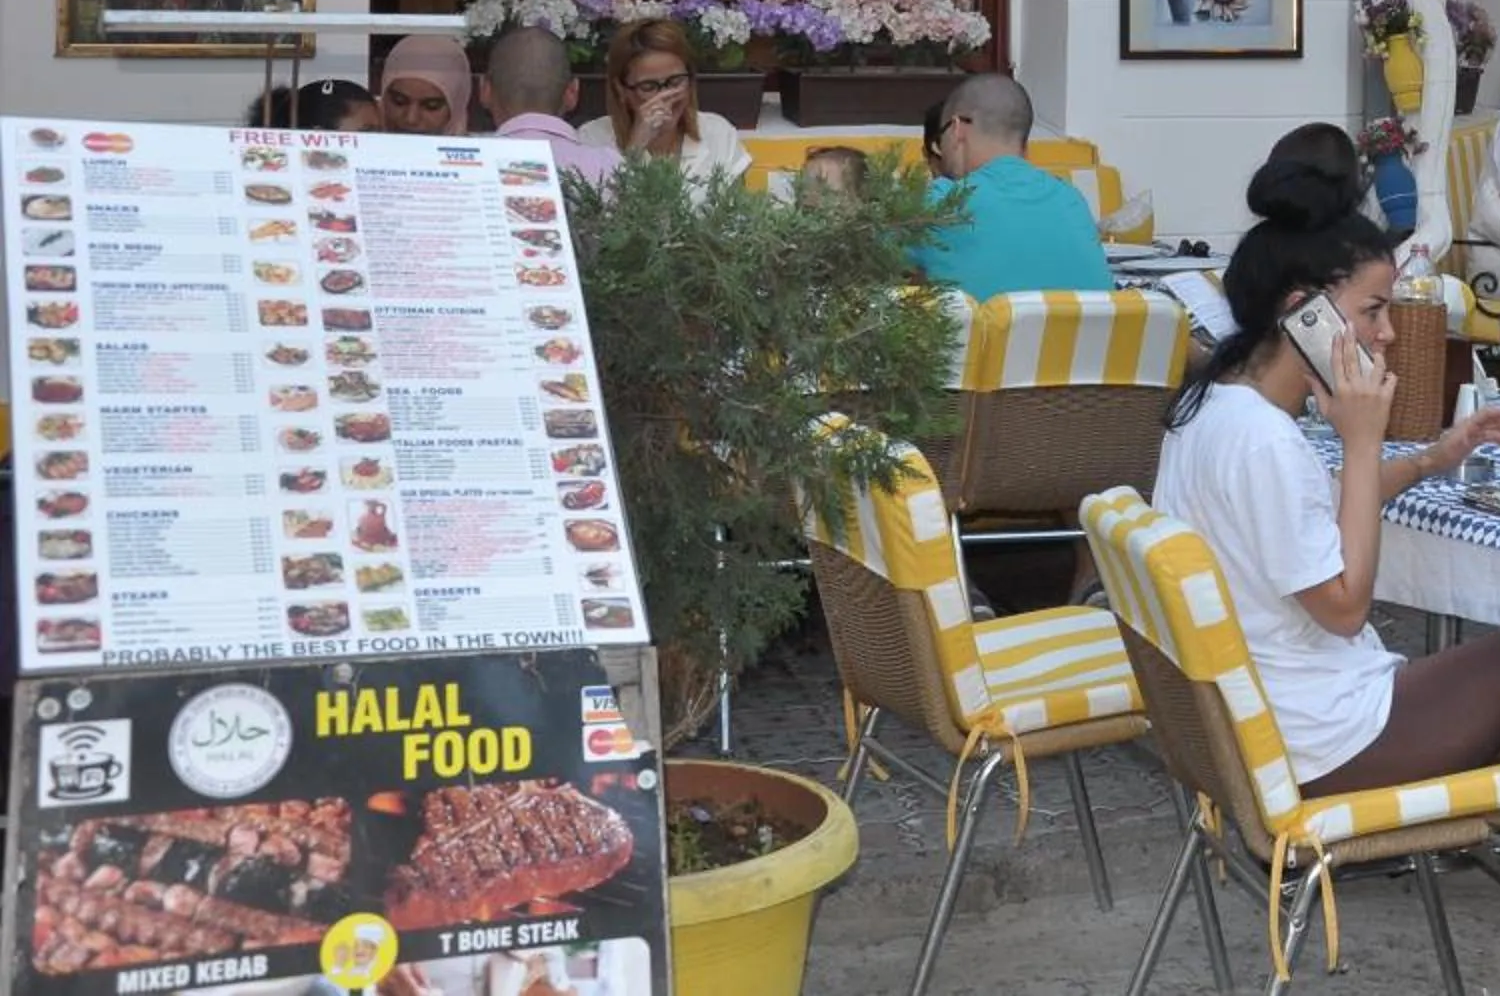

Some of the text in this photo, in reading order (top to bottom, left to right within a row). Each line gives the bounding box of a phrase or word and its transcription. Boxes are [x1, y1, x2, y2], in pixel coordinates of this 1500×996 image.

[229, 130, 293, 145] FREE
[102, 630, 584, 668] PROBABLY THE BEST FOOD IN THE TOWN!!!
[191, 709, 270, 747] حلال
[316, 683, 472, 737] HALAL
[403, 726, 532, 781] FOOD
[440, 919, 580, 952] T BONE STEAK
[117, 955, 268, 995] MIXED KEBAB
